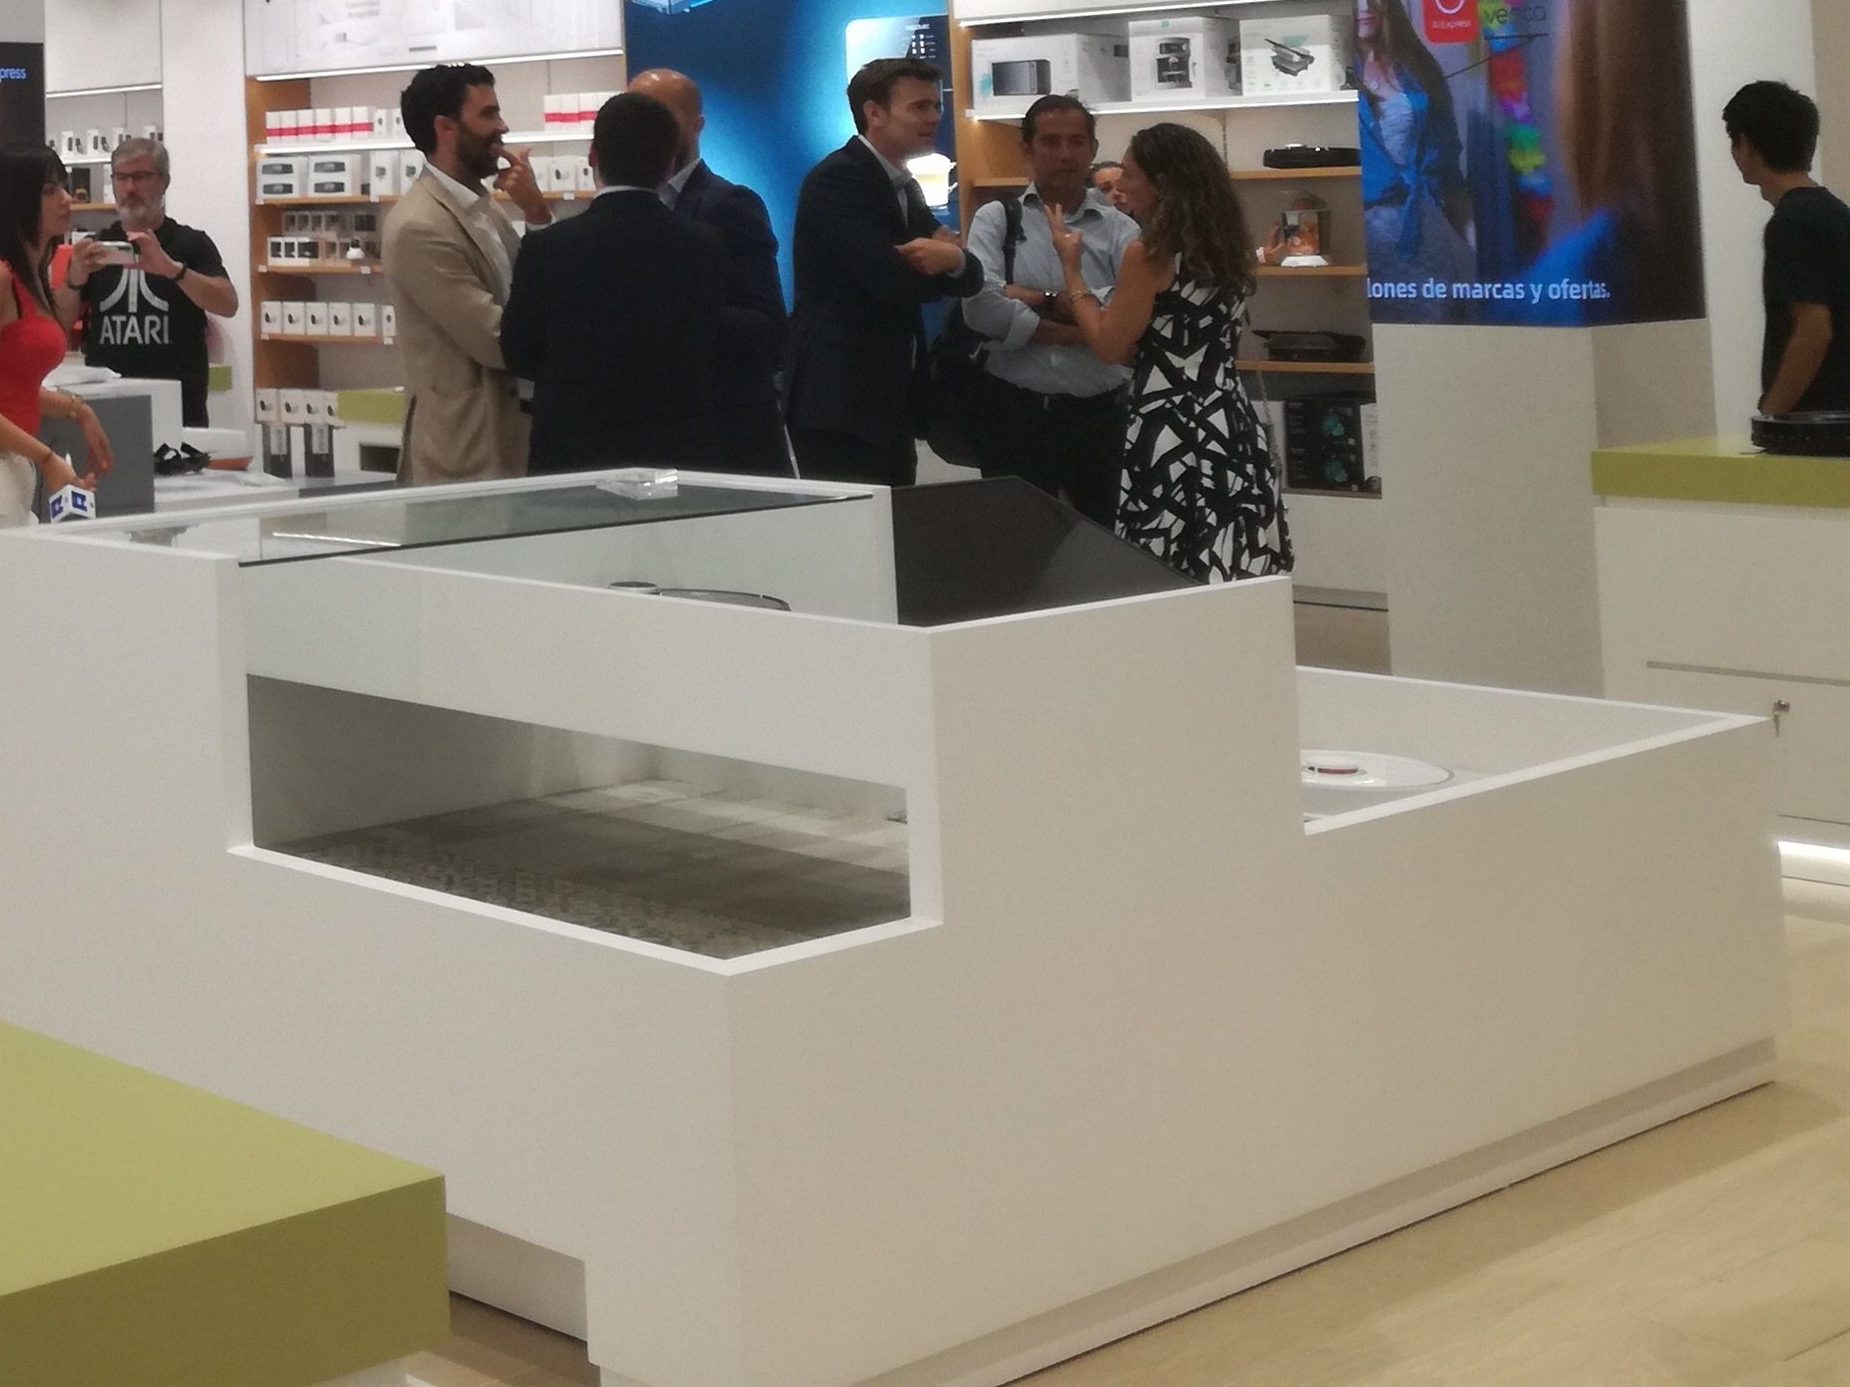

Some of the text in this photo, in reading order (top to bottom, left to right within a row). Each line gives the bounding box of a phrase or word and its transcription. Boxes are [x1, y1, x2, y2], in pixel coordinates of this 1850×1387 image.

[1422, 277, 1448, 300] de
[1452, 280, 1526, 301] marcas
[1529, 282, 1544, 305] y
[1547, 277, 1611, 301] ofertas.
[101, 314, 170, 346] ATARI
